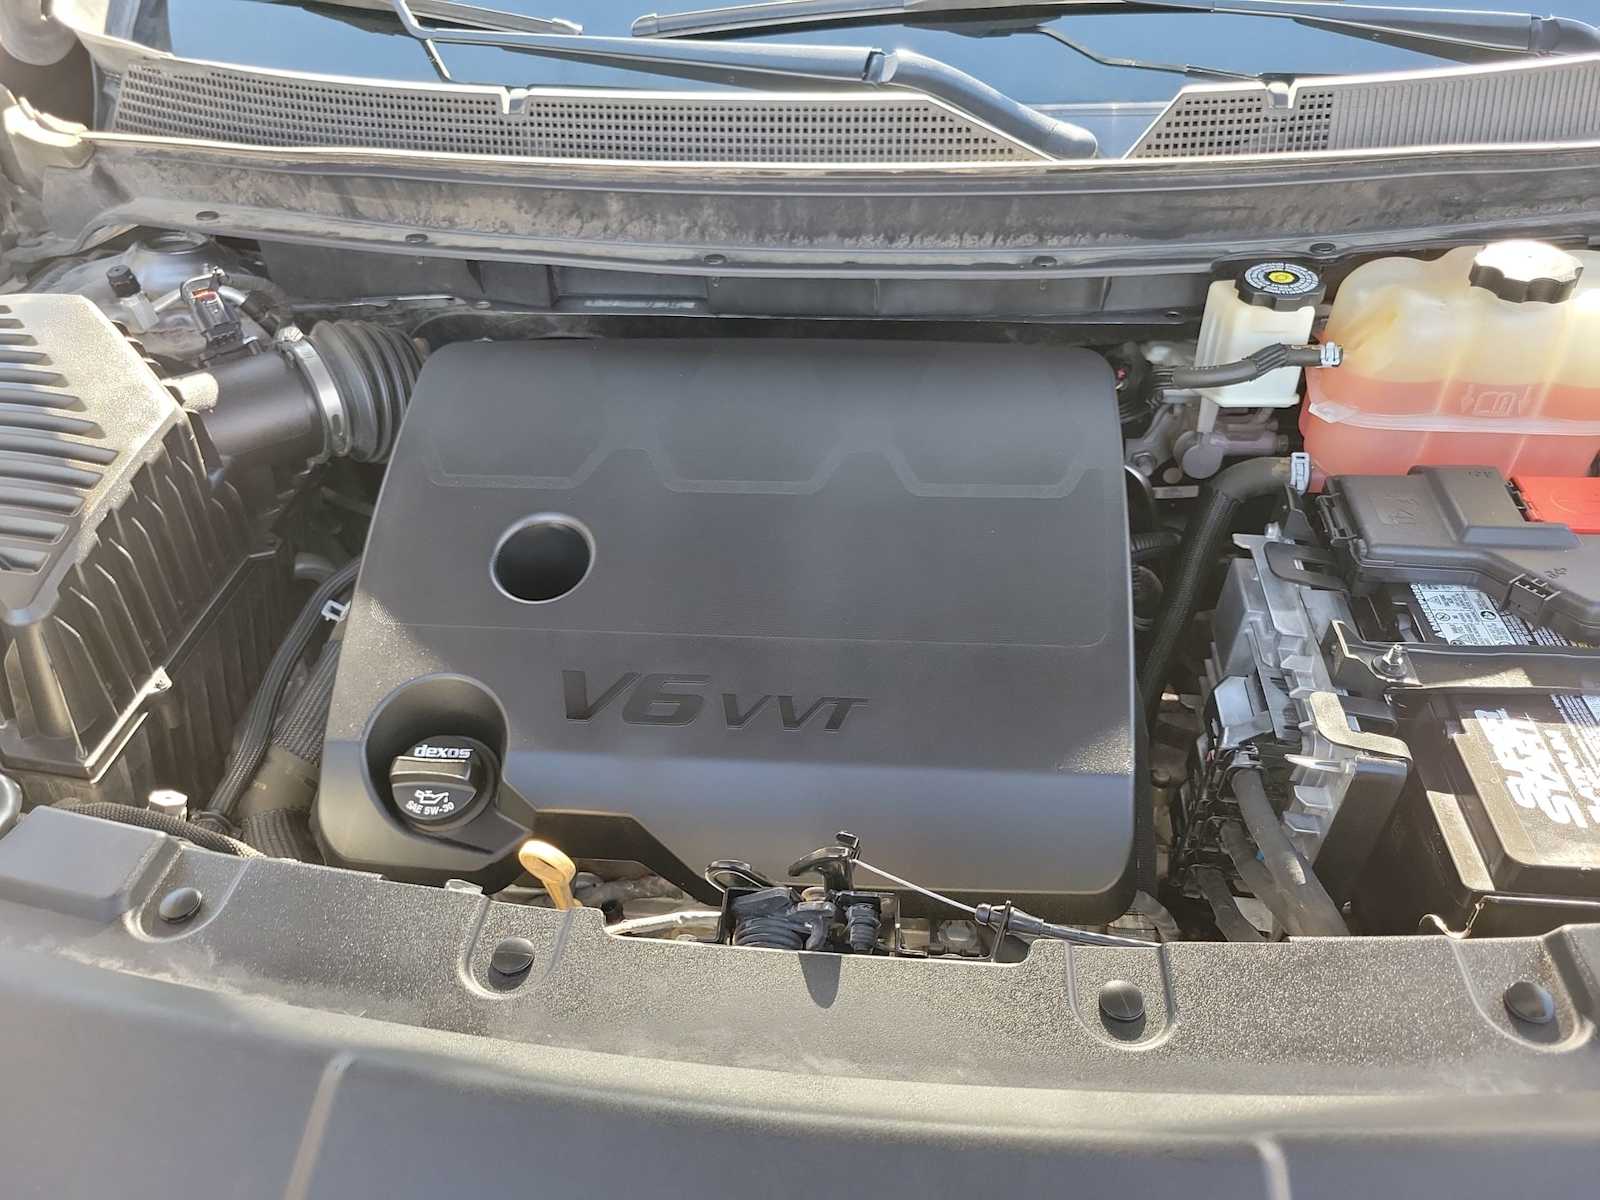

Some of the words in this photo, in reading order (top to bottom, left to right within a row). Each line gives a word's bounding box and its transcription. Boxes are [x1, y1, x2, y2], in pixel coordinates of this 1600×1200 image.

[562, 670, 712, 728] V6
[721, 693, 870, 732] VVT
[414, 744, 474, 759] dexos
[405, 800, 423, 814] SAE
[424, 801, 455, 816] 5W-30
